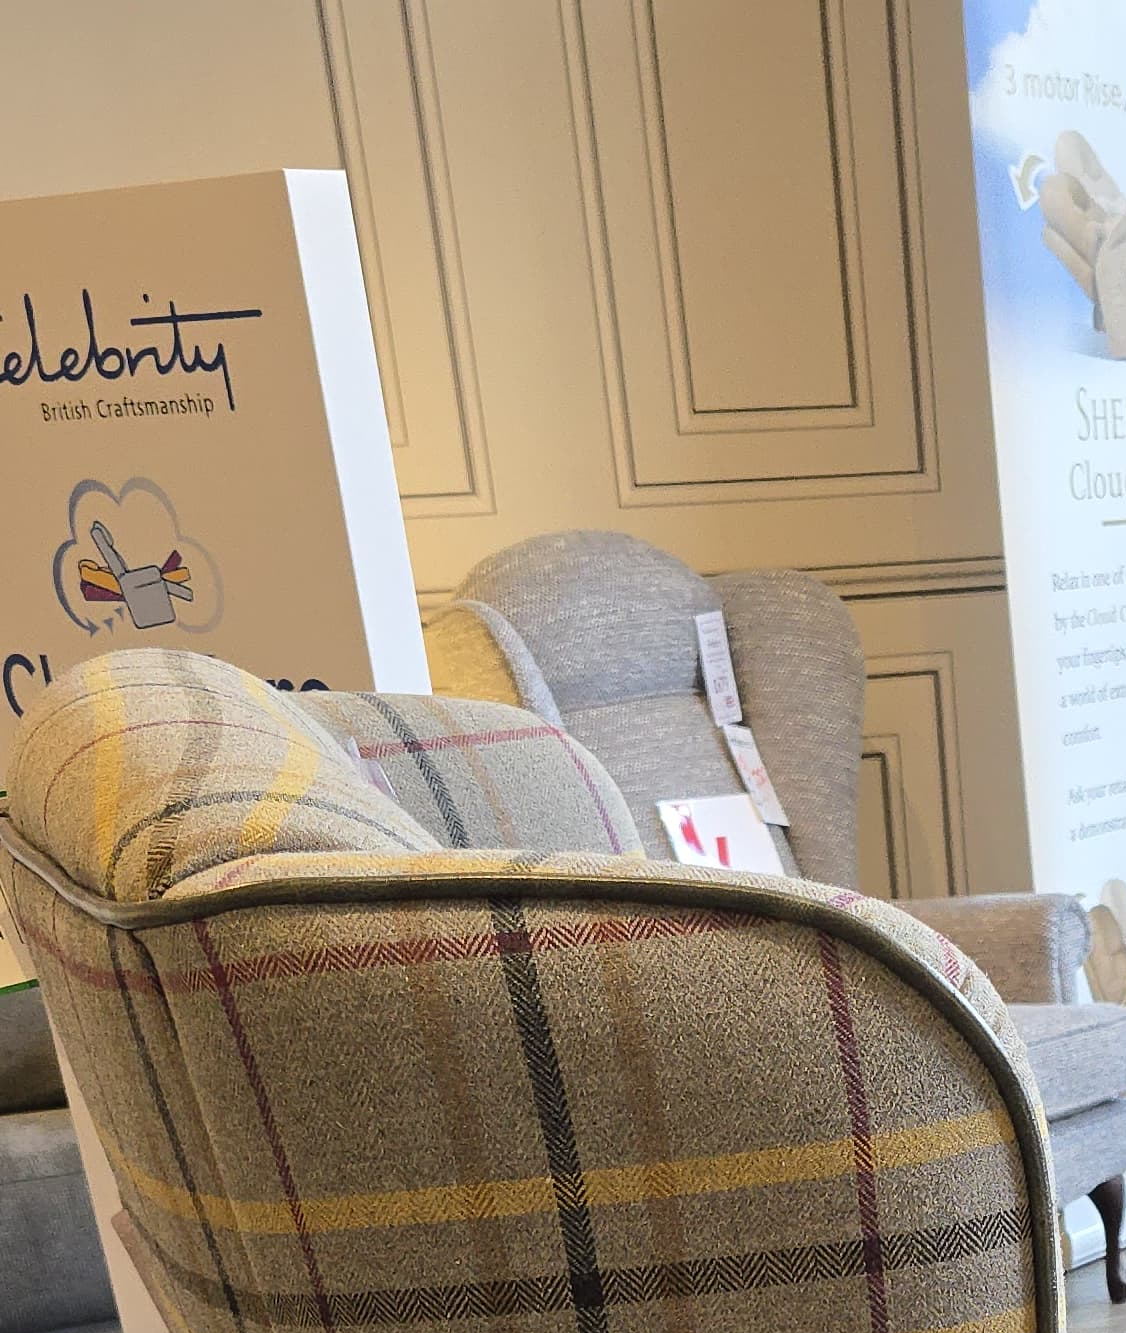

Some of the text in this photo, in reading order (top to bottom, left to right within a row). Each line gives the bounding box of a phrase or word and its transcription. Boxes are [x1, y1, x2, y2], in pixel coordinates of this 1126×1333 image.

[1004, 63, 1018, 96] 3
[1024, 71, 1081, 101] motor
[0, 288, 262, 412] elebrity
[41, 393, 214, 422] British Craftsmanship
